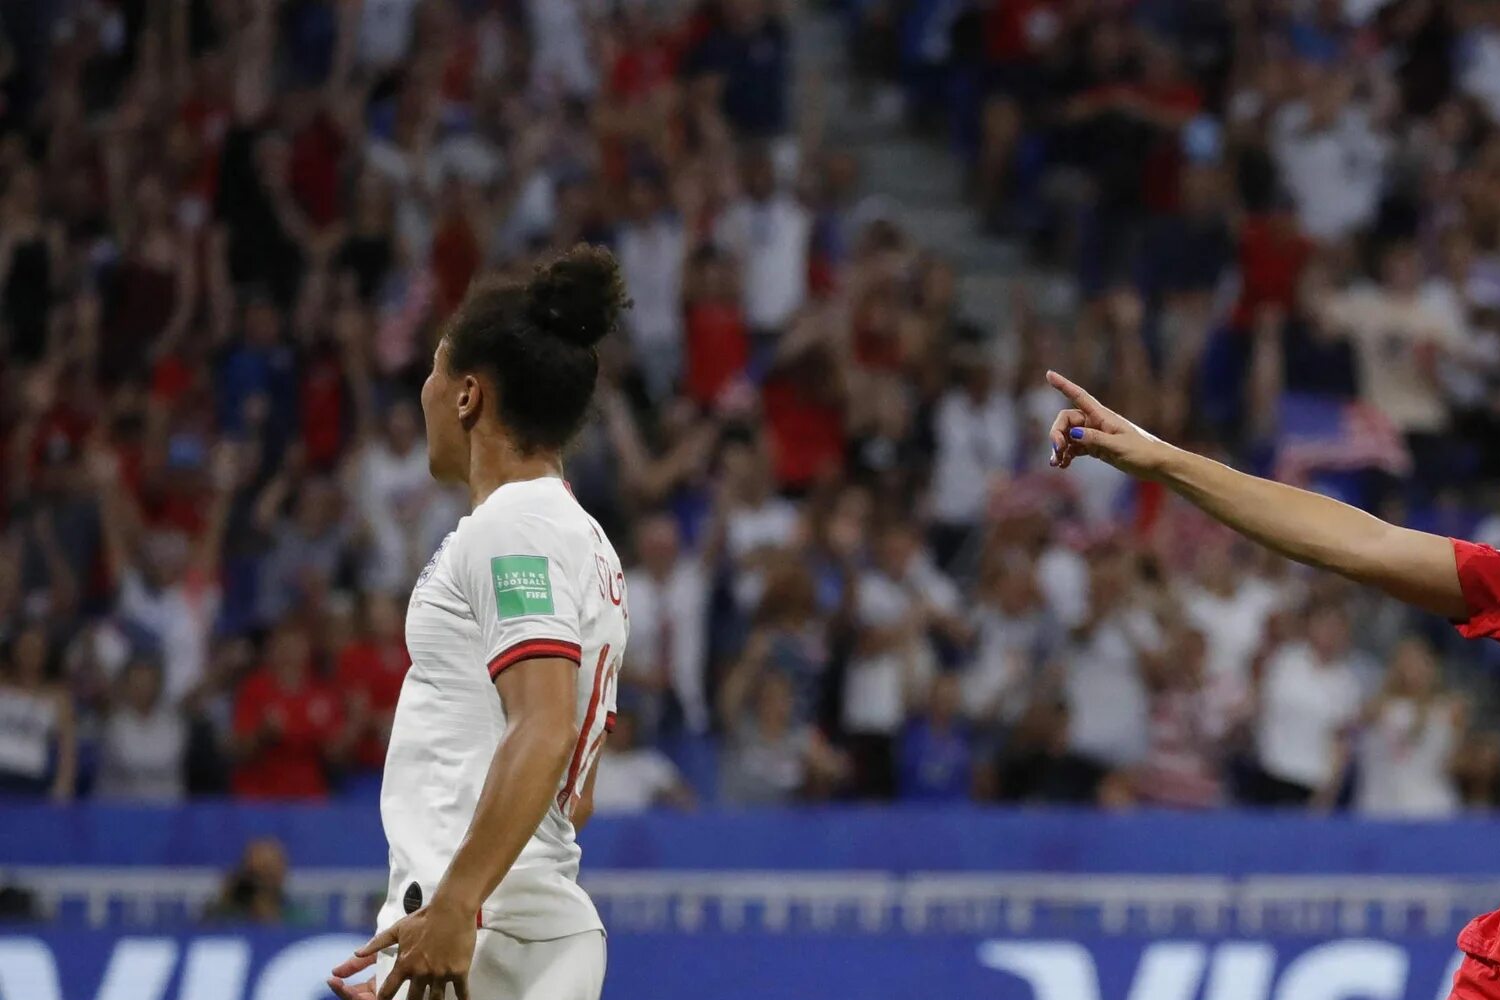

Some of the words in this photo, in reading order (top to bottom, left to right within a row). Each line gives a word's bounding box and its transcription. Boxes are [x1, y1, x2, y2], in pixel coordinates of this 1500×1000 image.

[497, 571, 545, 581] LIVING
[497, 578, 547, 589] FOOTBALL
[526, 591, 548, 600] FIFA
